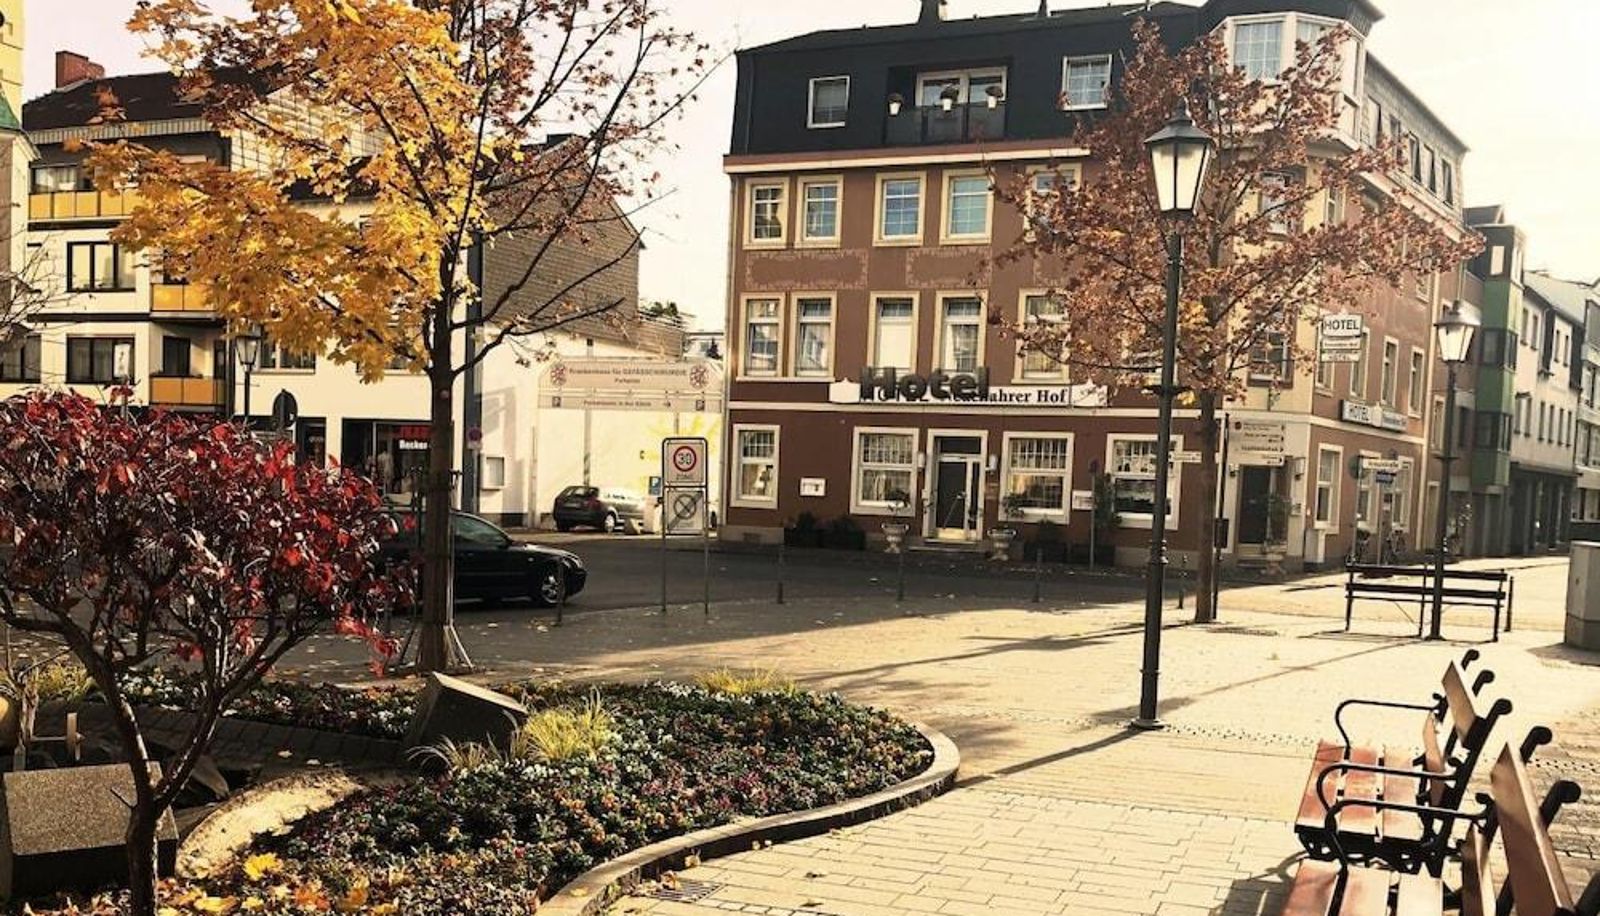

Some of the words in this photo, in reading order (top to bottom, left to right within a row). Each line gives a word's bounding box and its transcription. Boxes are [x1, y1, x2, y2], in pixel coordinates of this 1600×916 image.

[1323, 319, 1359, 330] HOTEL
[860, 366, 990, 401] Hotel
[1037, 388, 1068, 403] Hof
[1349, 404, 1369, 421] HOTEL
[678, 453, 692, 465] 30
